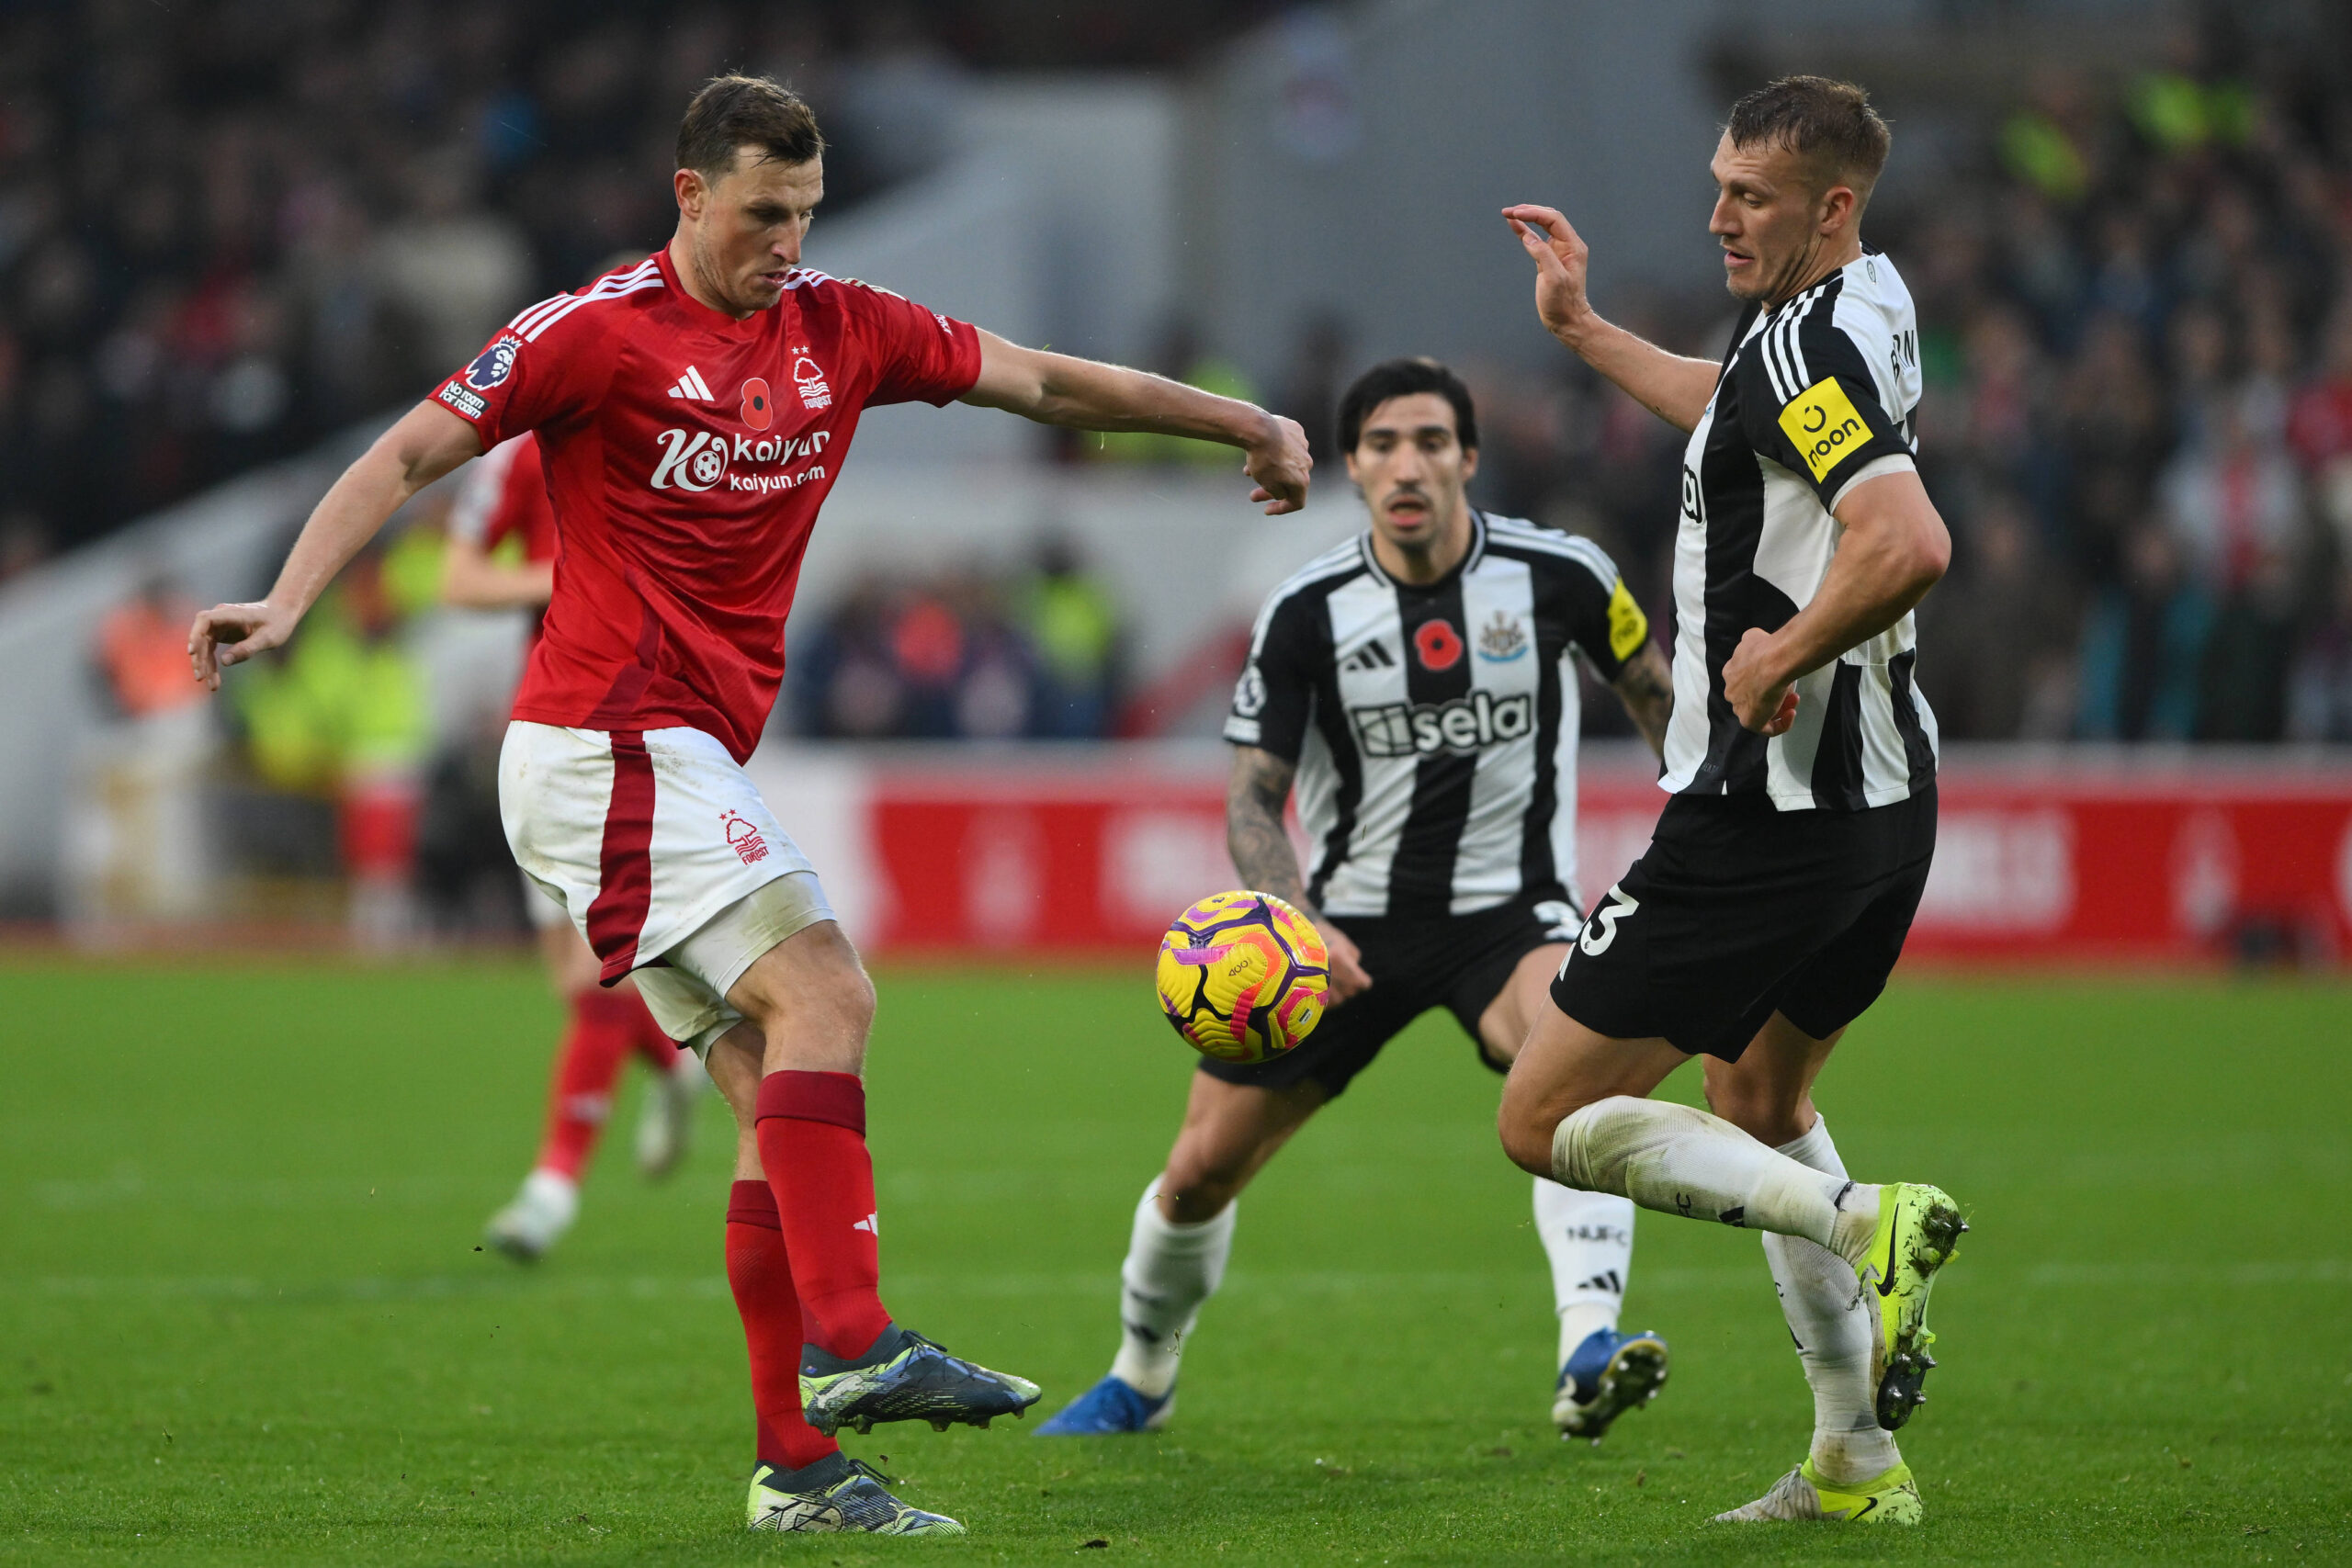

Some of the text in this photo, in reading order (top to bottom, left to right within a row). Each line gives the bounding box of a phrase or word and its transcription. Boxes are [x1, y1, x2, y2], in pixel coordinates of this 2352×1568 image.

[1891, 330, 1917, 386] BRN
[446, 380, 485, 409] No room
[1808, 418, 1860, 468] noon
[1412, 692, 1532, 753] sela
